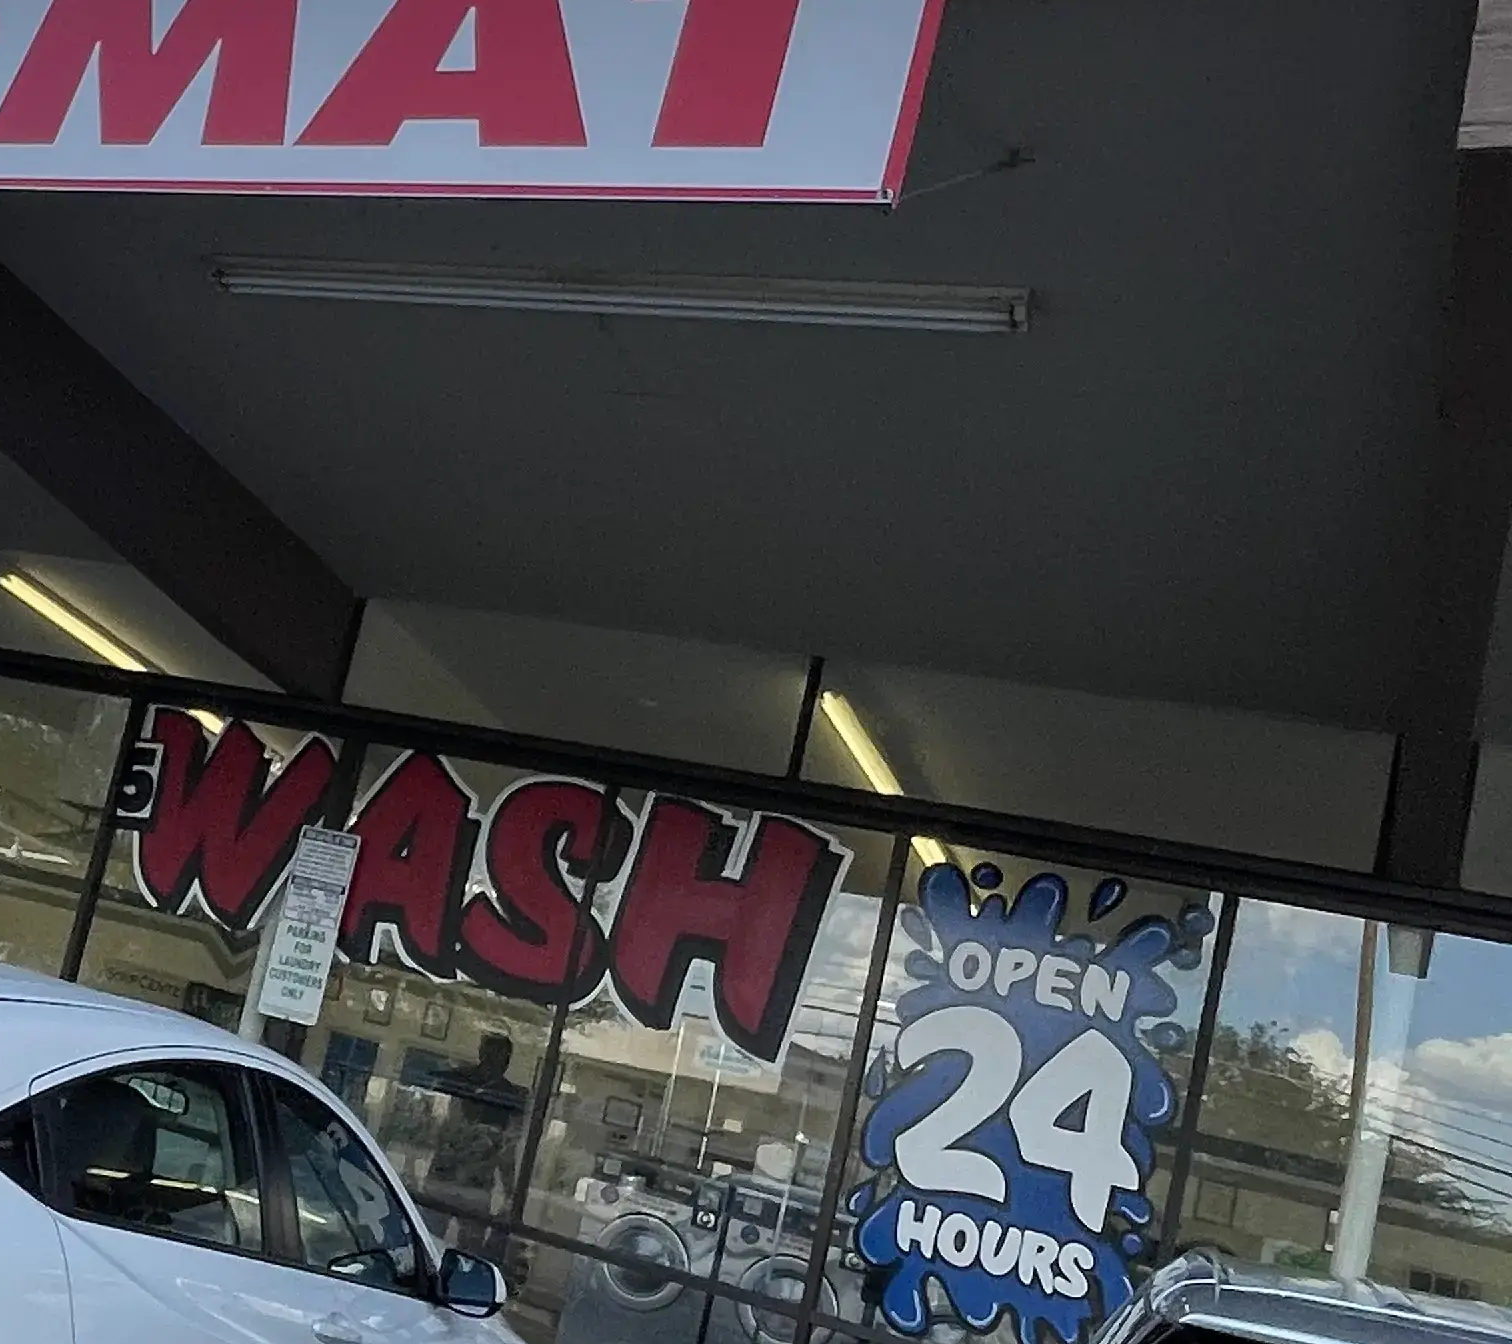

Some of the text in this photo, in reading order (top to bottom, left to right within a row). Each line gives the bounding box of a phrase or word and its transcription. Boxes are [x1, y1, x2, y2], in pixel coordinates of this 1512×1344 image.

[133, 704, 854, 1074] WASH
[287, 924, 326, 943] PARKING
[294, 940, 312, 954] FOR
[279, 955, 322, 972] LAUNDRY
[269, 967, 323, 989] CUSTOMERS
[948, 941, 1131, 1022] OPEN
[281, 986, 305, 1000] ONLY
[895, 1005, 1140, 1234] 24
[896, 1200, 1095, 1299] HOURS
